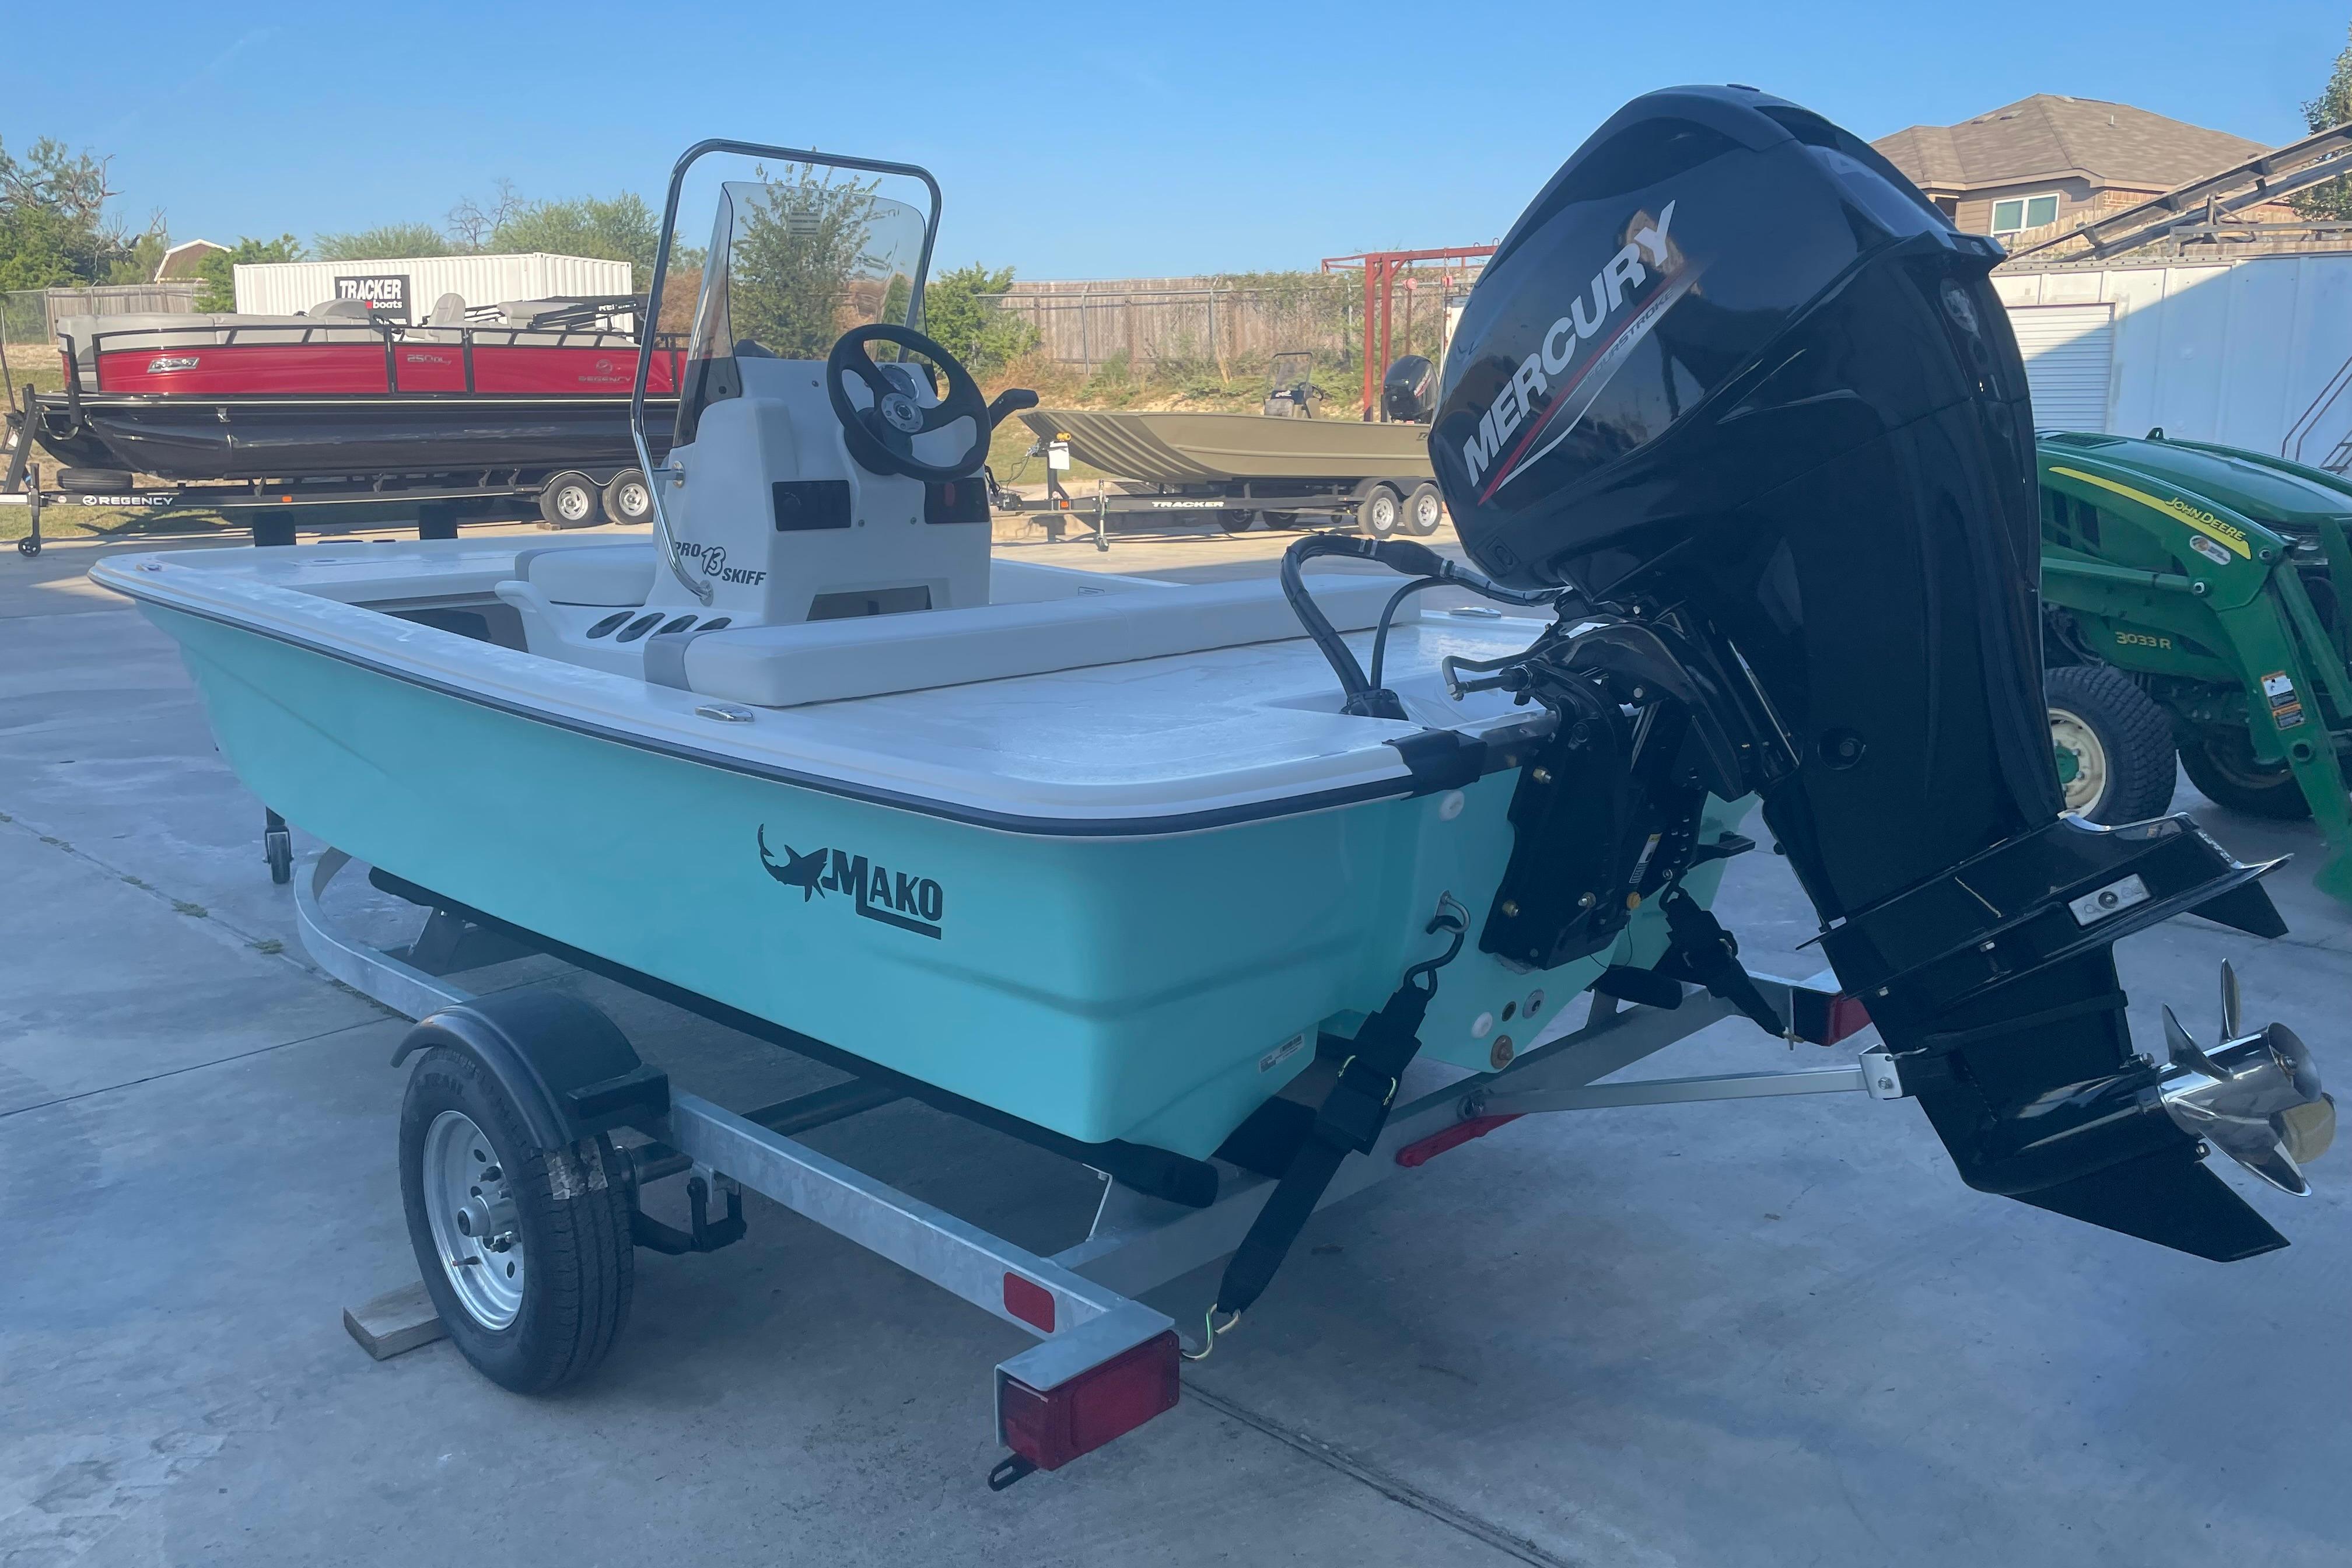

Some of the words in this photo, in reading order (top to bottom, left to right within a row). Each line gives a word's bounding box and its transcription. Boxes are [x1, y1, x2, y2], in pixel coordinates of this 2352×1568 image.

[340, 279, 402, 300] TRACKER
[372, 300, 402, 309] boats
[1462, 200, 1676, 487] MERCURY
[1586, 288, 1673, 383] FOURSTROKE
[99, 496, 173, 505] REGENCY
[2165, 497, 2202, 519] JOHN
[2199, 512, 2246, 541] DEERE
[701, 546, 726, 576] 13
[722, 568, 767, 586] SKIFF
[820, 848, 943, 940] MAKO
